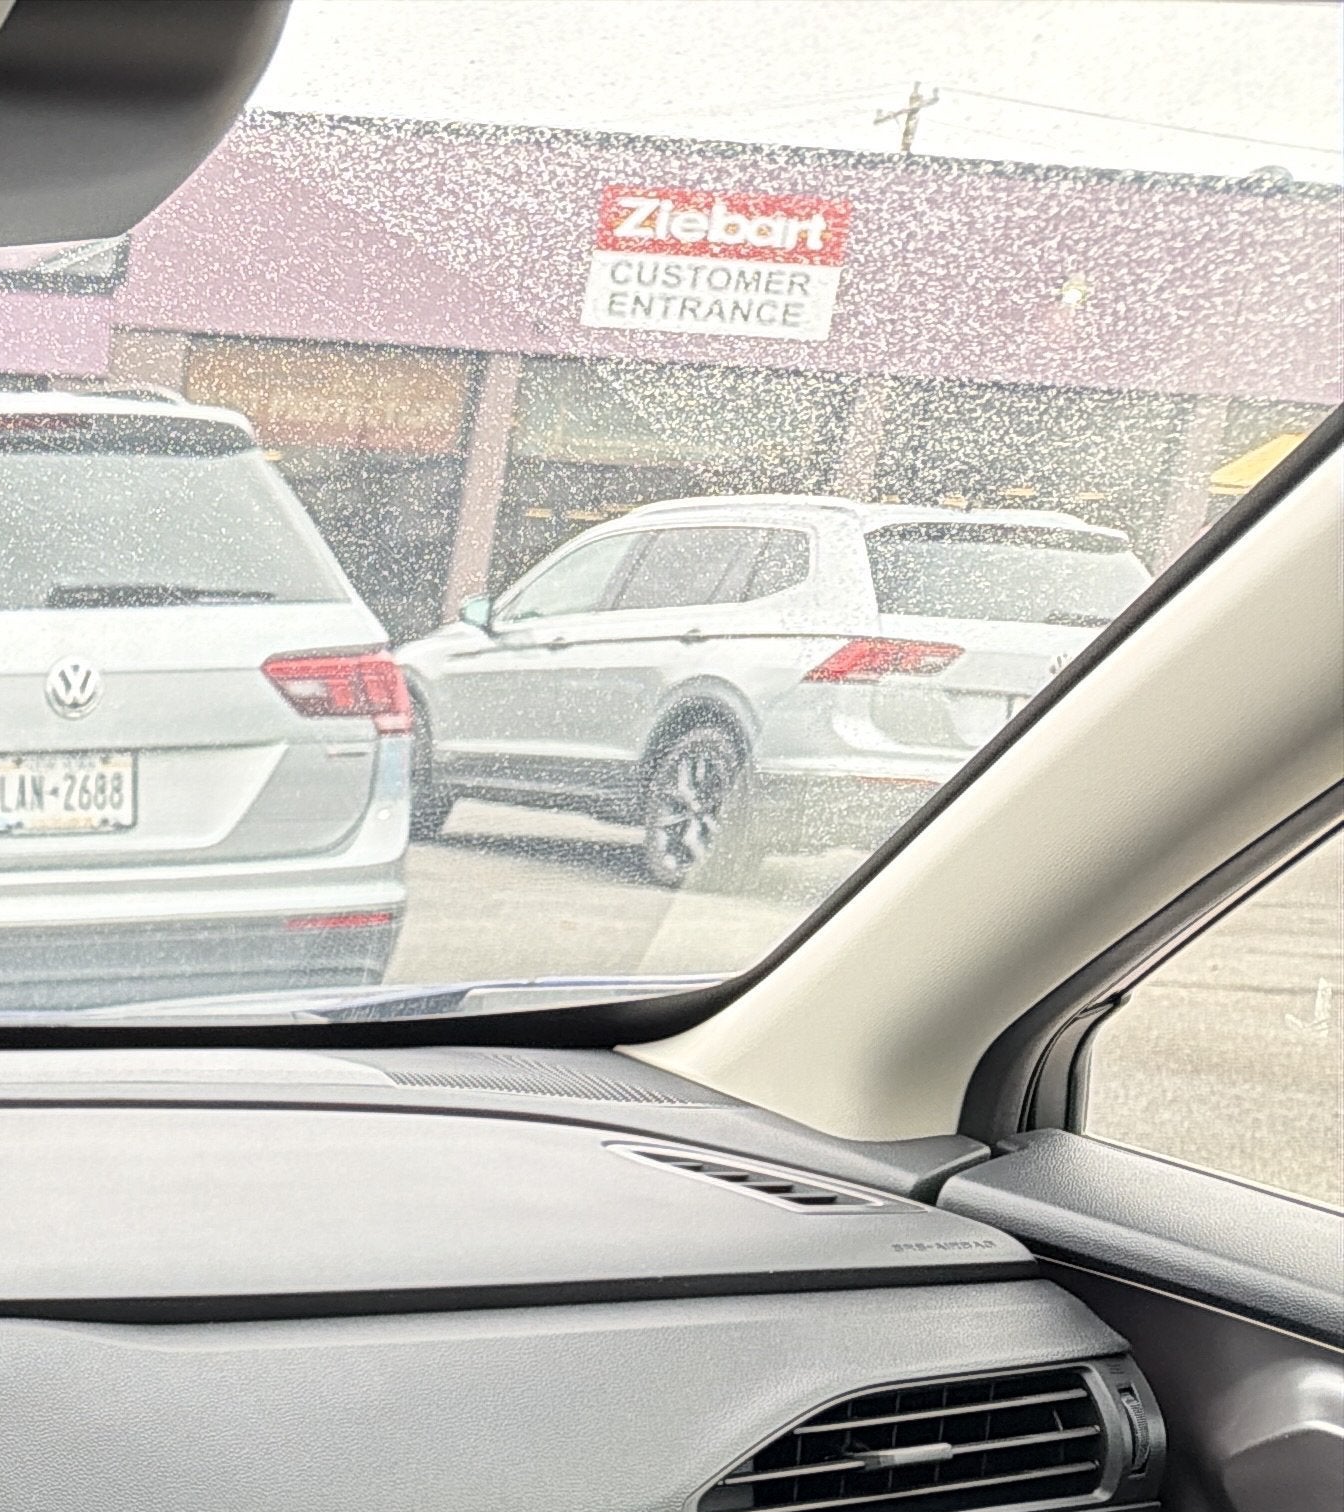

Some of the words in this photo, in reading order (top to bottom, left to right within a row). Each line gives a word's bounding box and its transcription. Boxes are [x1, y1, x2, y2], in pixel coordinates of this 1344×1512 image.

[612, 196, 828, 251] Ziebart
[611, 260, 811, 296] CUSTOMER
[608, 291, 806, 327] ENTRANCE
